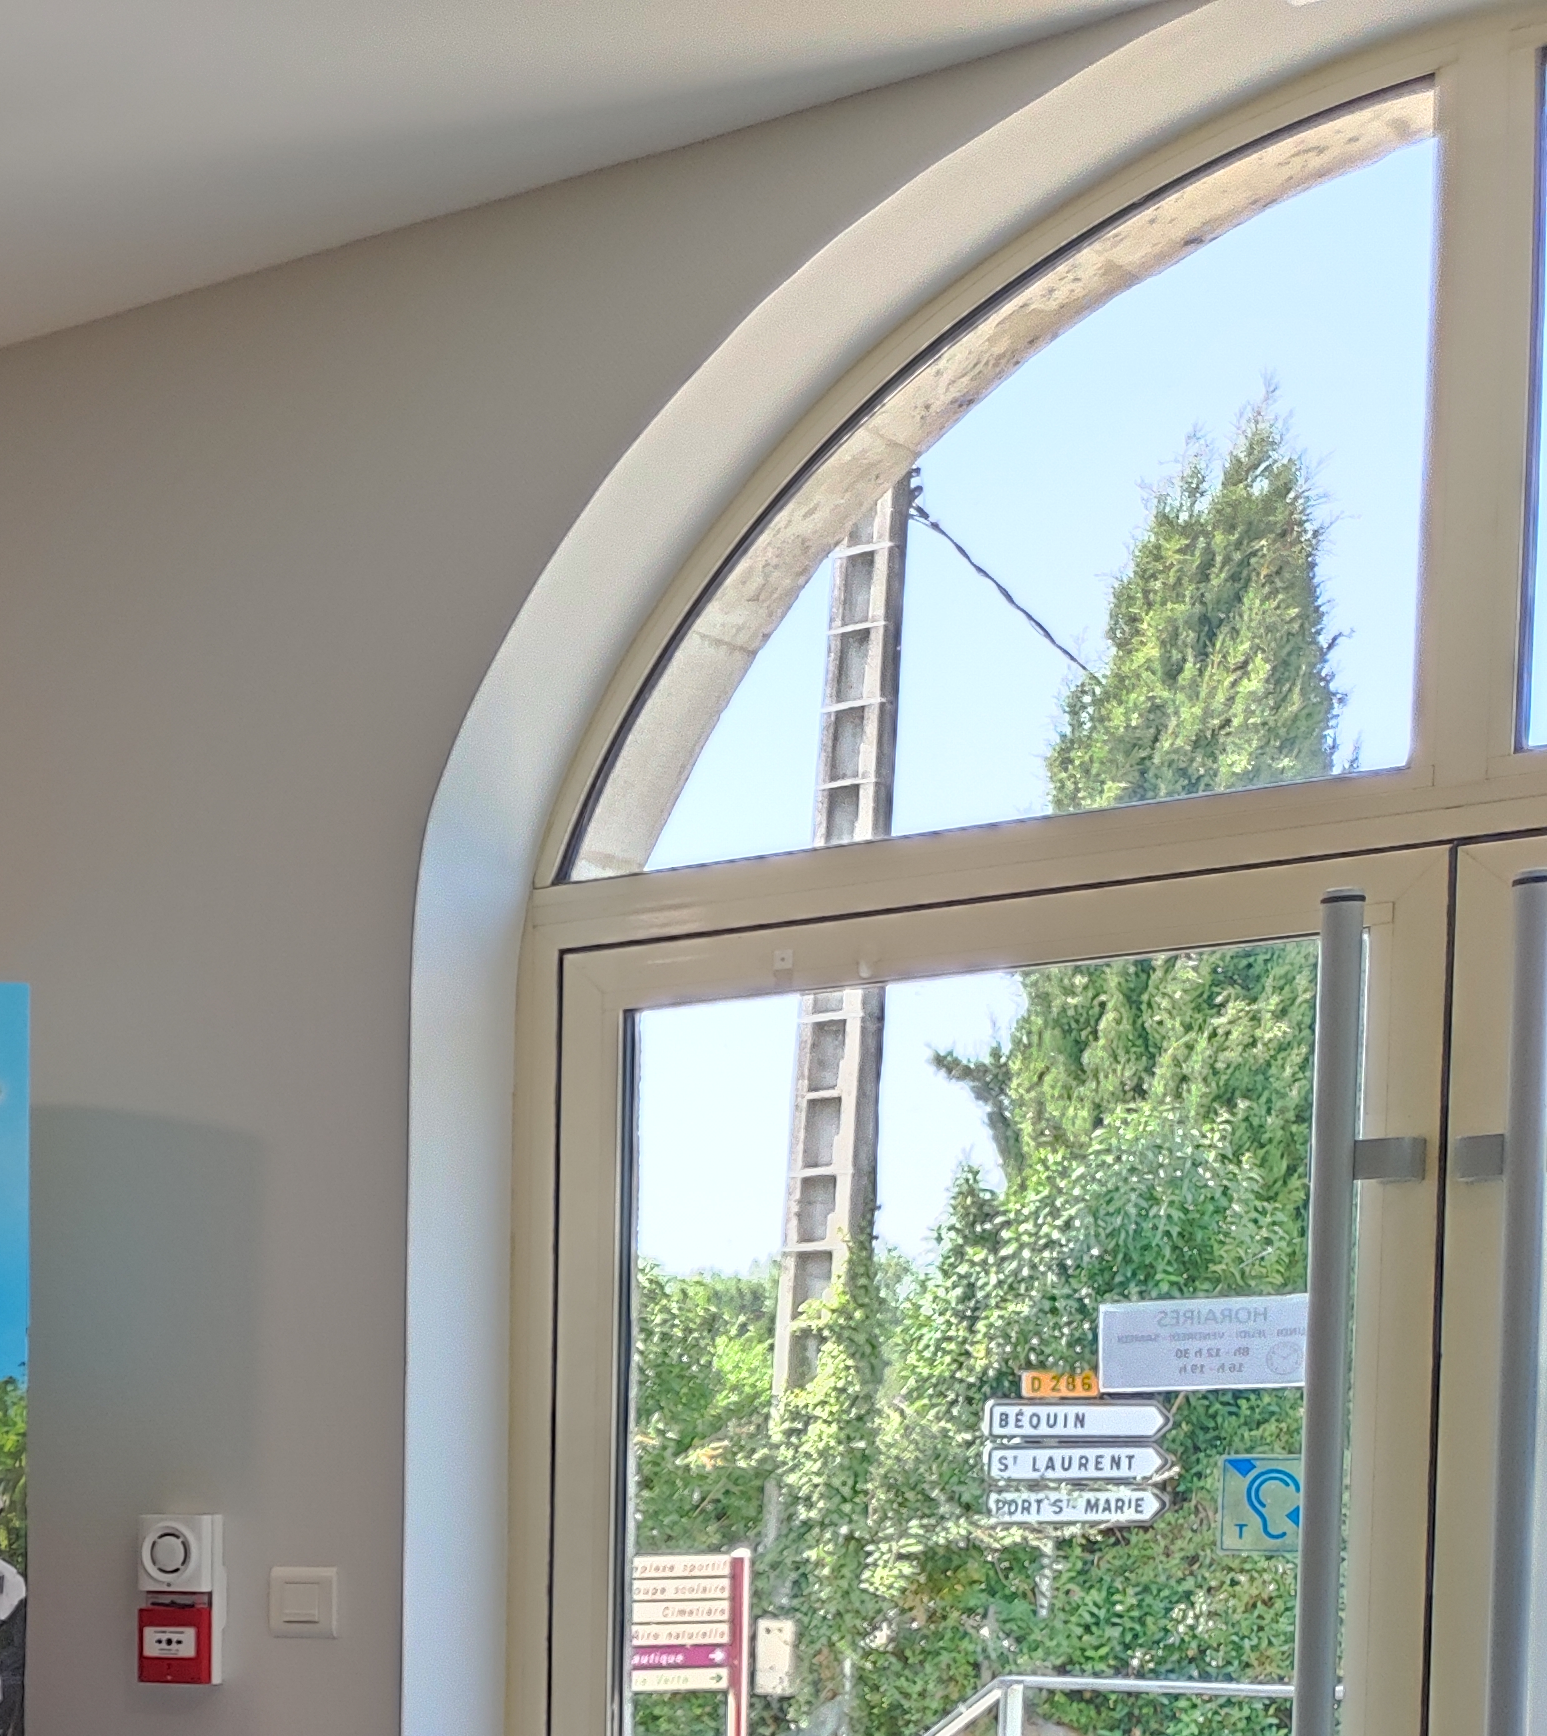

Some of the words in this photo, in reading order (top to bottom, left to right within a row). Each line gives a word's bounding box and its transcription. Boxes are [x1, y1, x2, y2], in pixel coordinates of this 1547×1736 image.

[1031, 1378, 1041, 1393] D
[1051, 1375, 1092, 1392] 286
[999, 1409, 1086, 1429] BÉQUIN
[1032, 1454, 1136, 1472] LAURENT
[995, 1499, 1042, 1515] PORT
[1085, 1498, 1145, 1515] MARIE
[1234, 1523, 1248, 1540] T
